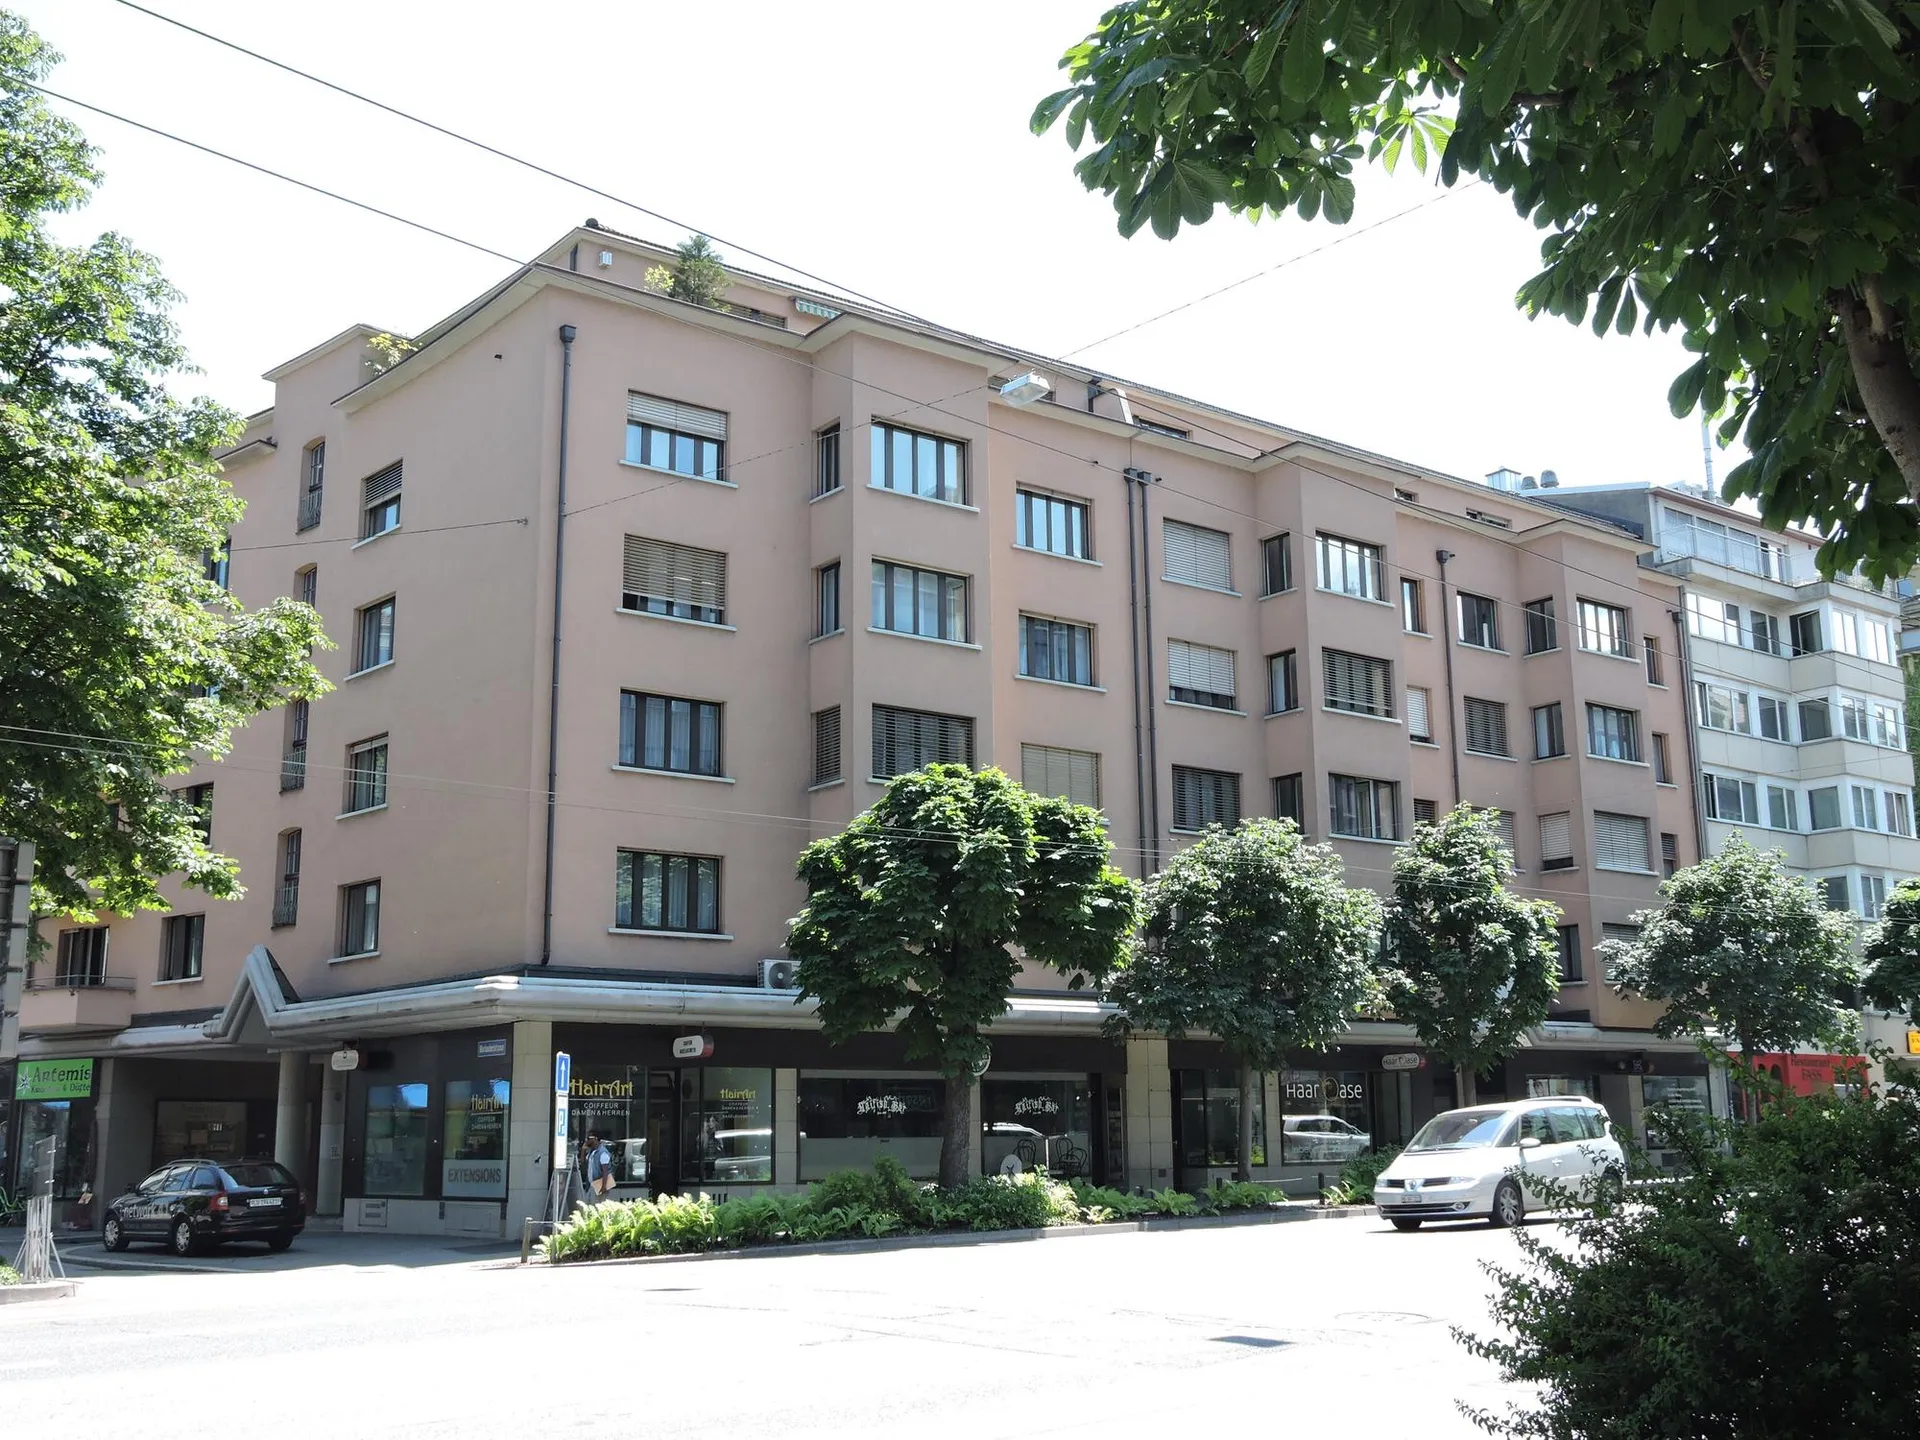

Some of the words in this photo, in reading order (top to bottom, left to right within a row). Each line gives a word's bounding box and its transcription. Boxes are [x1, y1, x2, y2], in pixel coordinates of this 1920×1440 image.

[32, 1065, 91, 1083] Artemis
[569, 1079, 634, 1098] HairArt
[1286, 1083, 1320, 1098] Haar
[448, 1168, 502, 1184] EXTENSIONS
